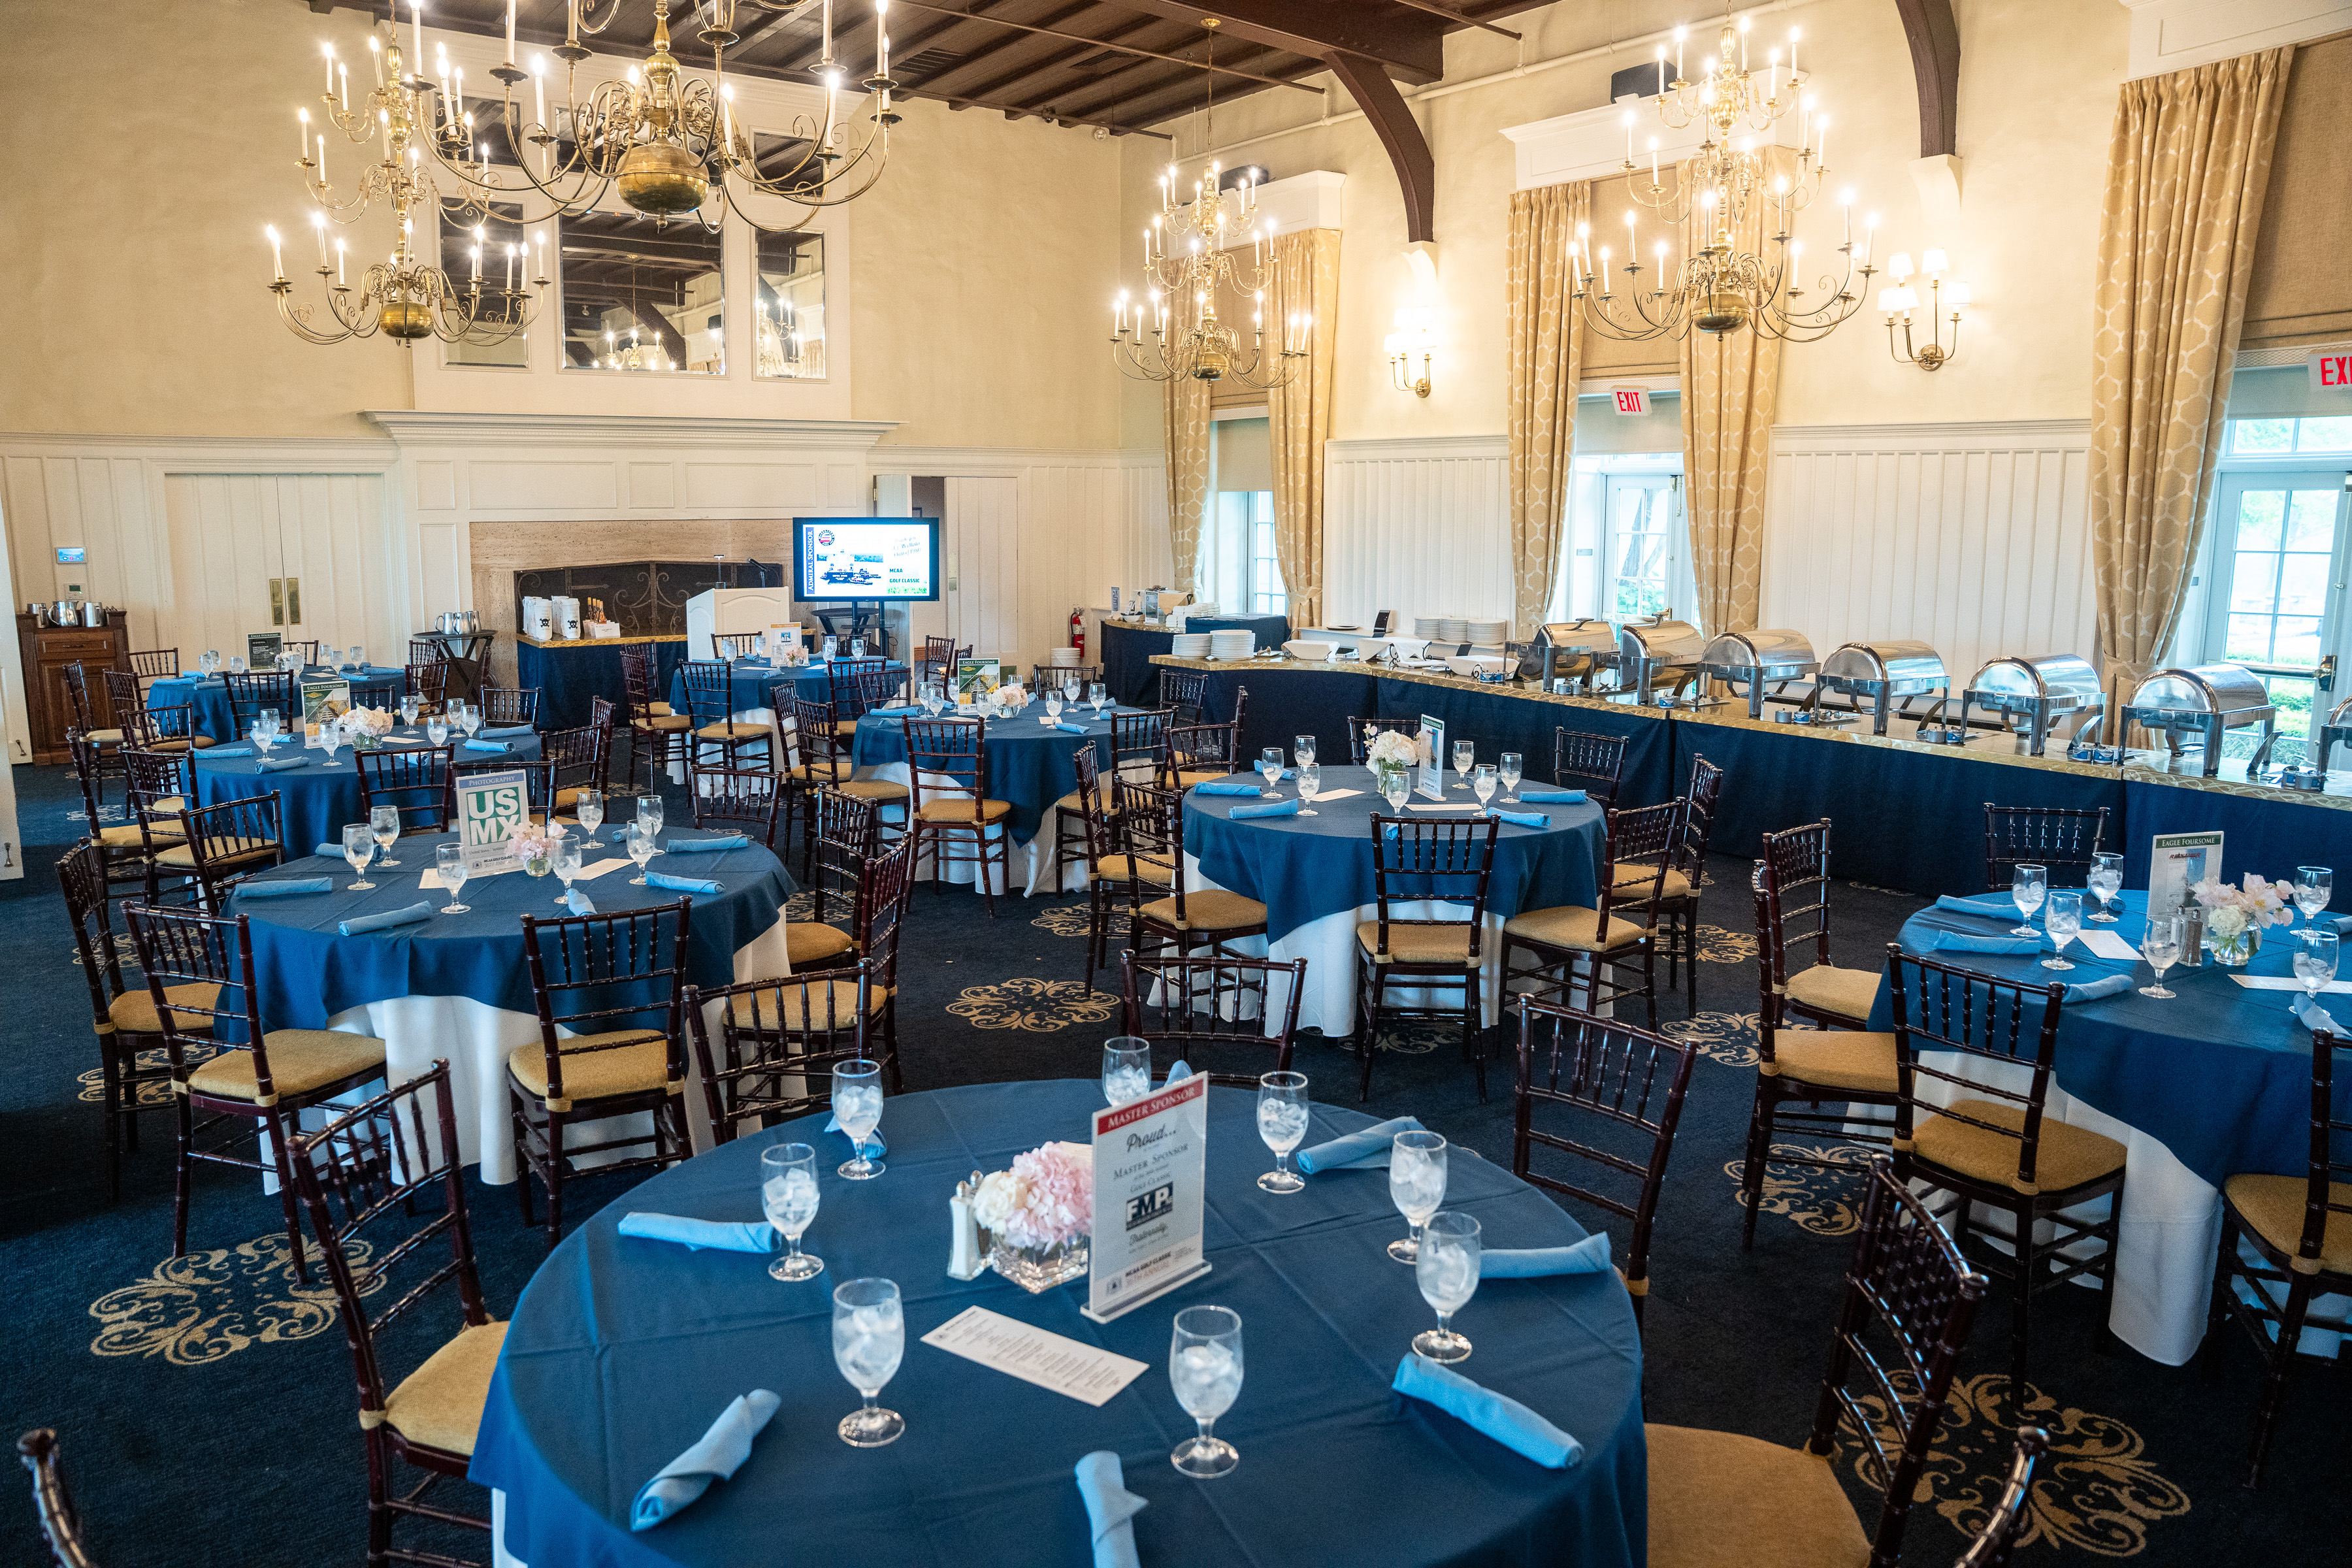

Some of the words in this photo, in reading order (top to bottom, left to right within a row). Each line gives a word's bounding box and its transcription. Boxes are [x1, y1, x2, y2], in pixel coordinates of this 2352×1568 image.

[2320, 355, 2352, 386] EXI
[1616, 391, 1642, 412] EXIT
[469, 776, 515, 786] PHOTOGRAPHY
[467, 789, 519, 819] US
[469, 814, 520, 846] MX
[2182, 837, 2215, 845] FOURSOME
[1107, 1105, 1149, 1129] MASTER
[1150, 1086, 1195, 1111] SPONSOR
[1126, 1123, 1177, 1153] Proud...
[1113, 1160, 1149, 1180] MASTER
[1152, 1143, 1188, 1165] SPONSOR
[1126, 1186, 1169, 1223] FMP
